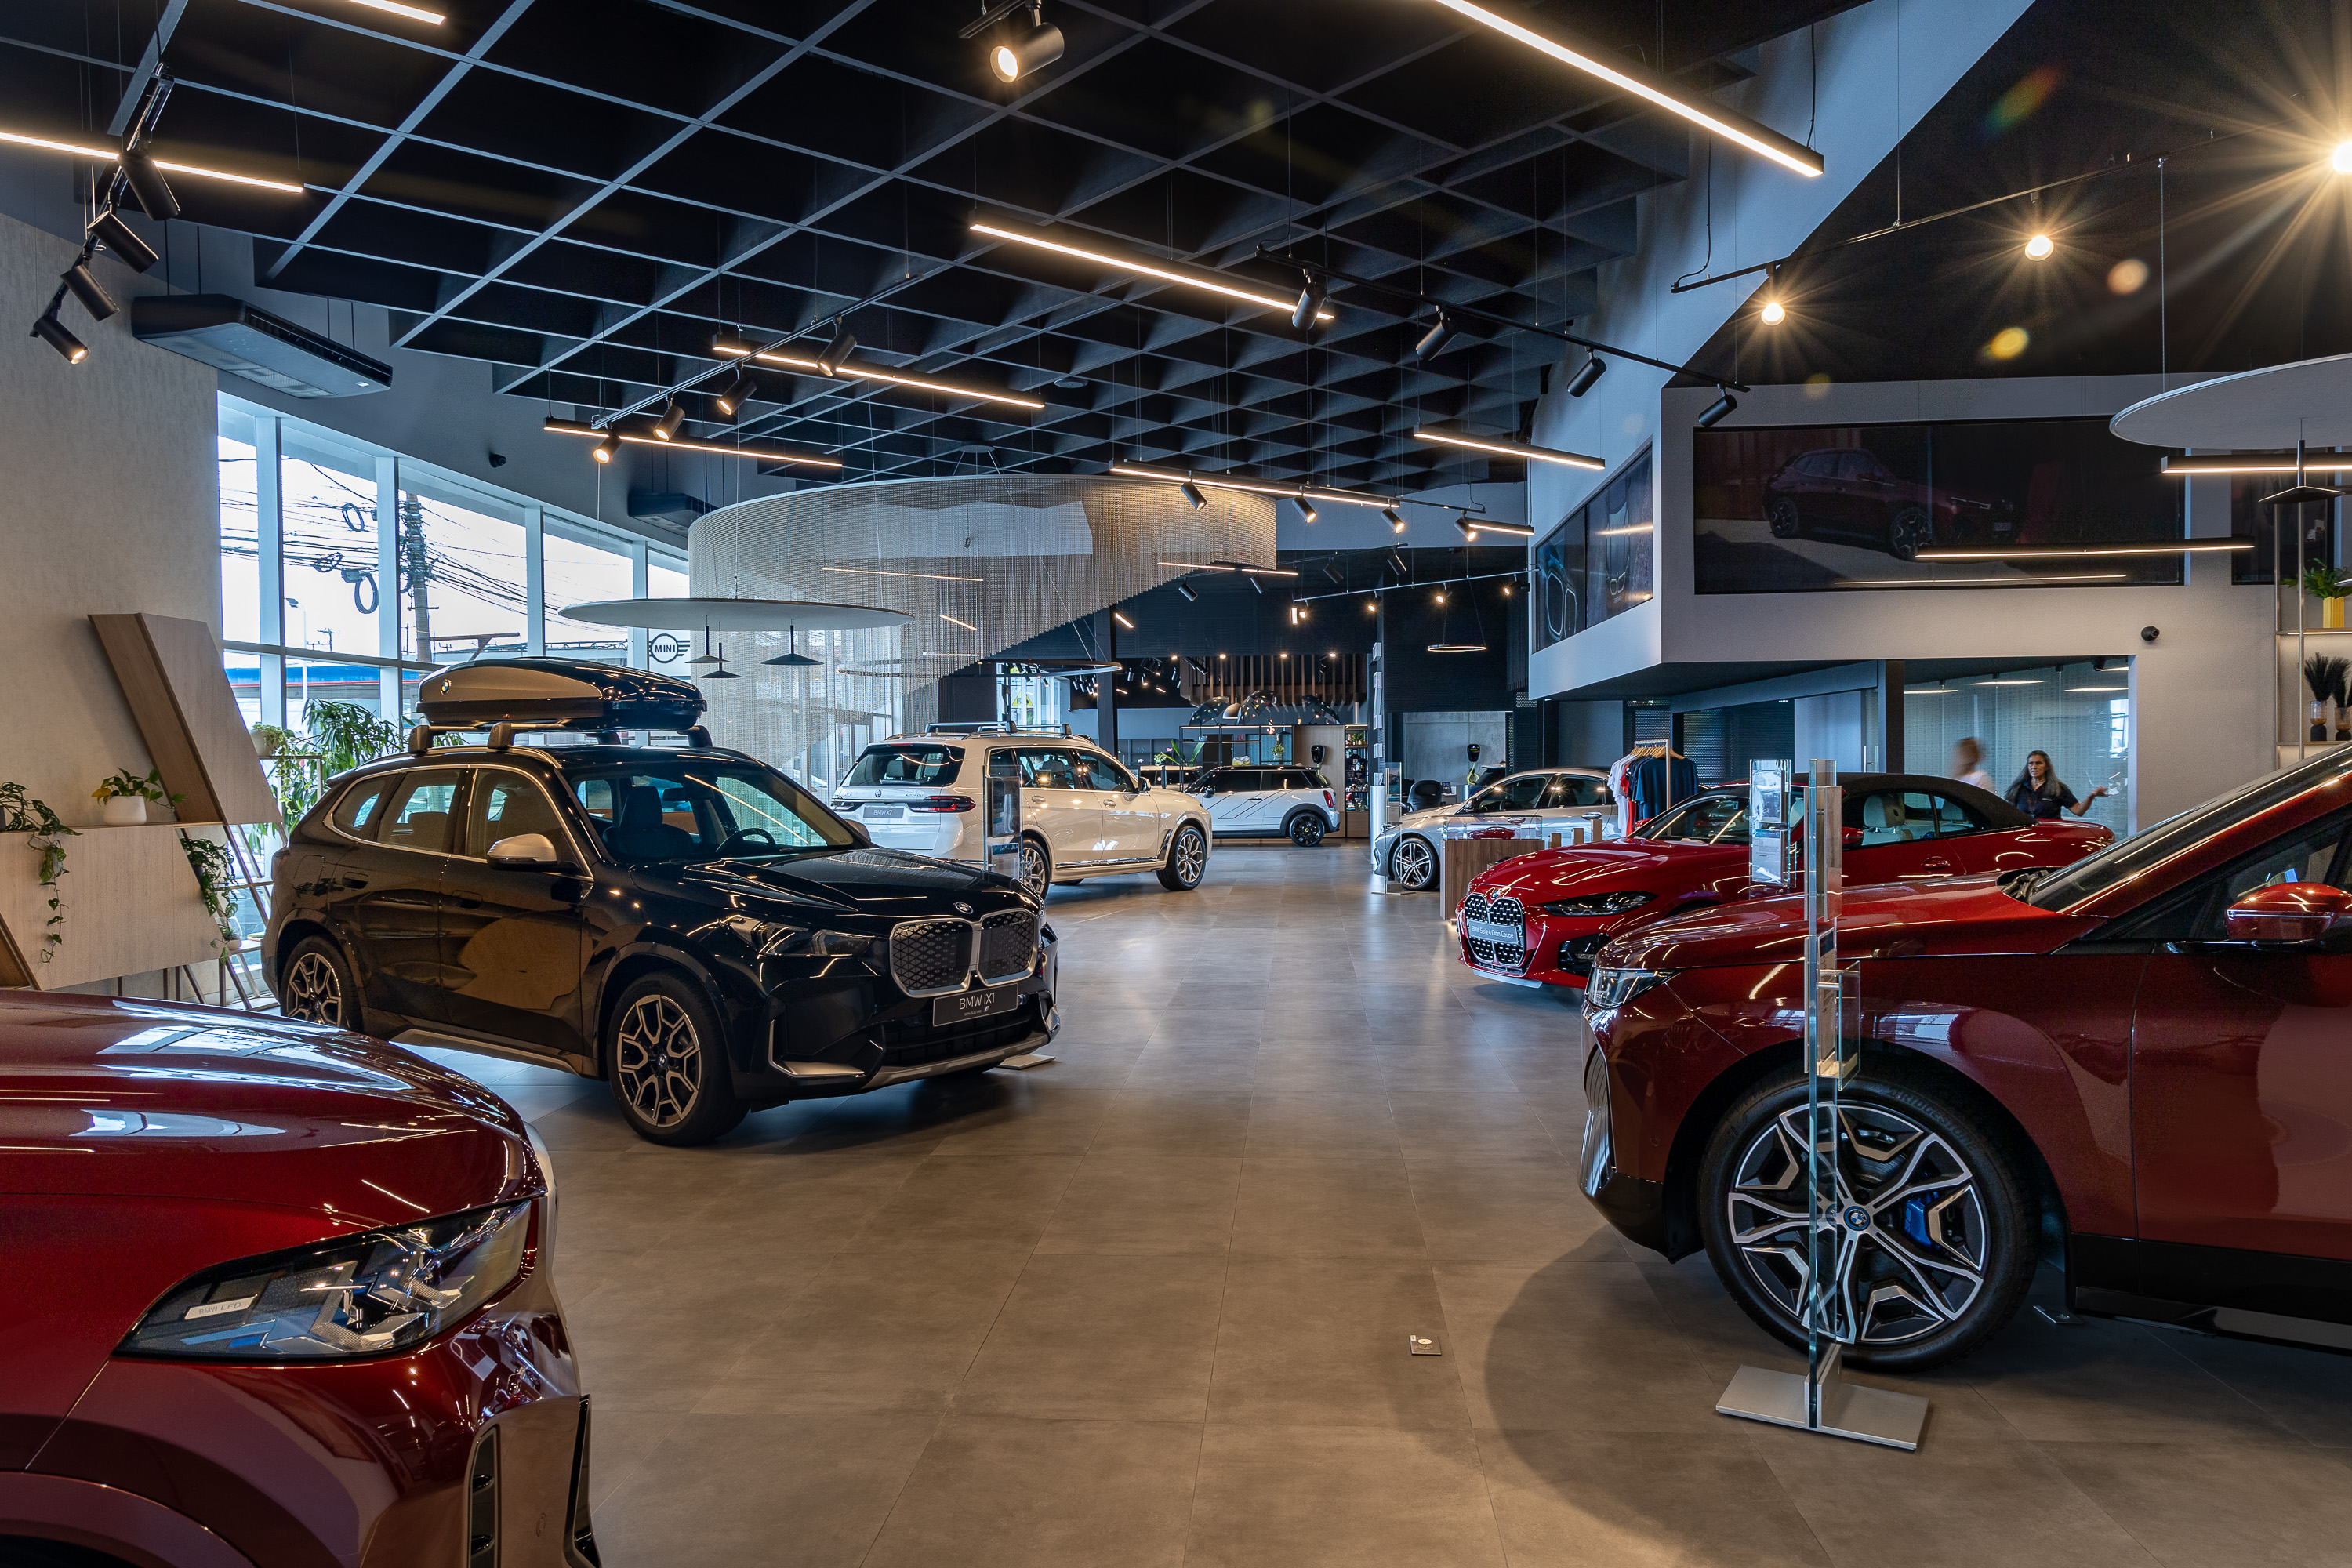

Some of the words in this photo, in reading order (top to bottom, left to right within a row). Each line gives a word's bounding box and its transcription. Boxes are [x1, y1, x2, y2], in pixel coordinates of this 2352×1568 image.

[959, 995, 982, 1010] BMW
[984, 992, 995, 1005] iX1
[221, 1302, 241, 1311] LED
